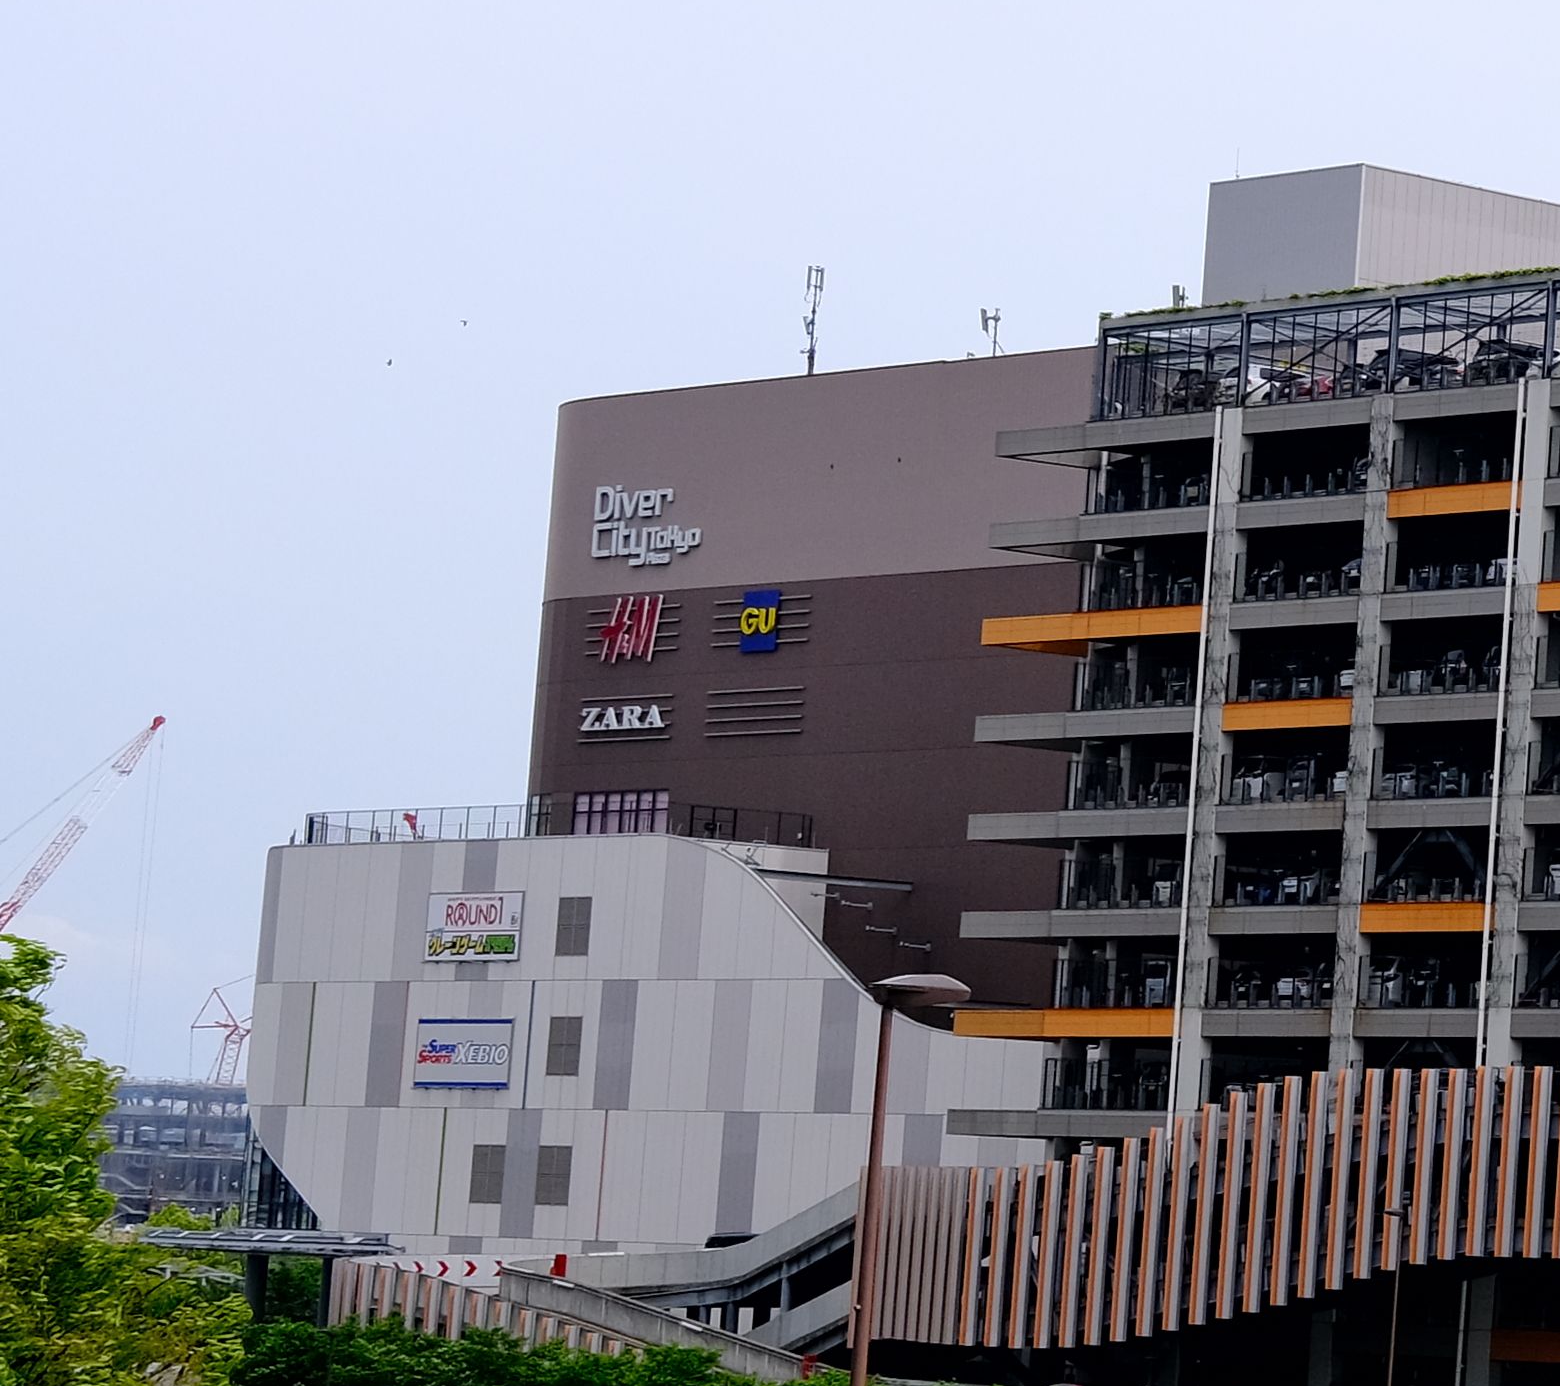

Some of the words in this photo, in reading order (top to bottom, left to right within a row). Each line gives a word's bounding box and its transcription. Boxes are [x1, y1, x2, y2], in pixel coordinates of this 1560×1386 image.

[593, 484, 674, 522] Diver
[591, 521, 649, 566] City
[600, 593, 664, 664] H&M
[740, 607, 777, 635] GU
[579, 704, 666, 732] ZARA
[445, 896, 504, 926] ROUND1
[455, 1040, 510, 1065] XEBIO
